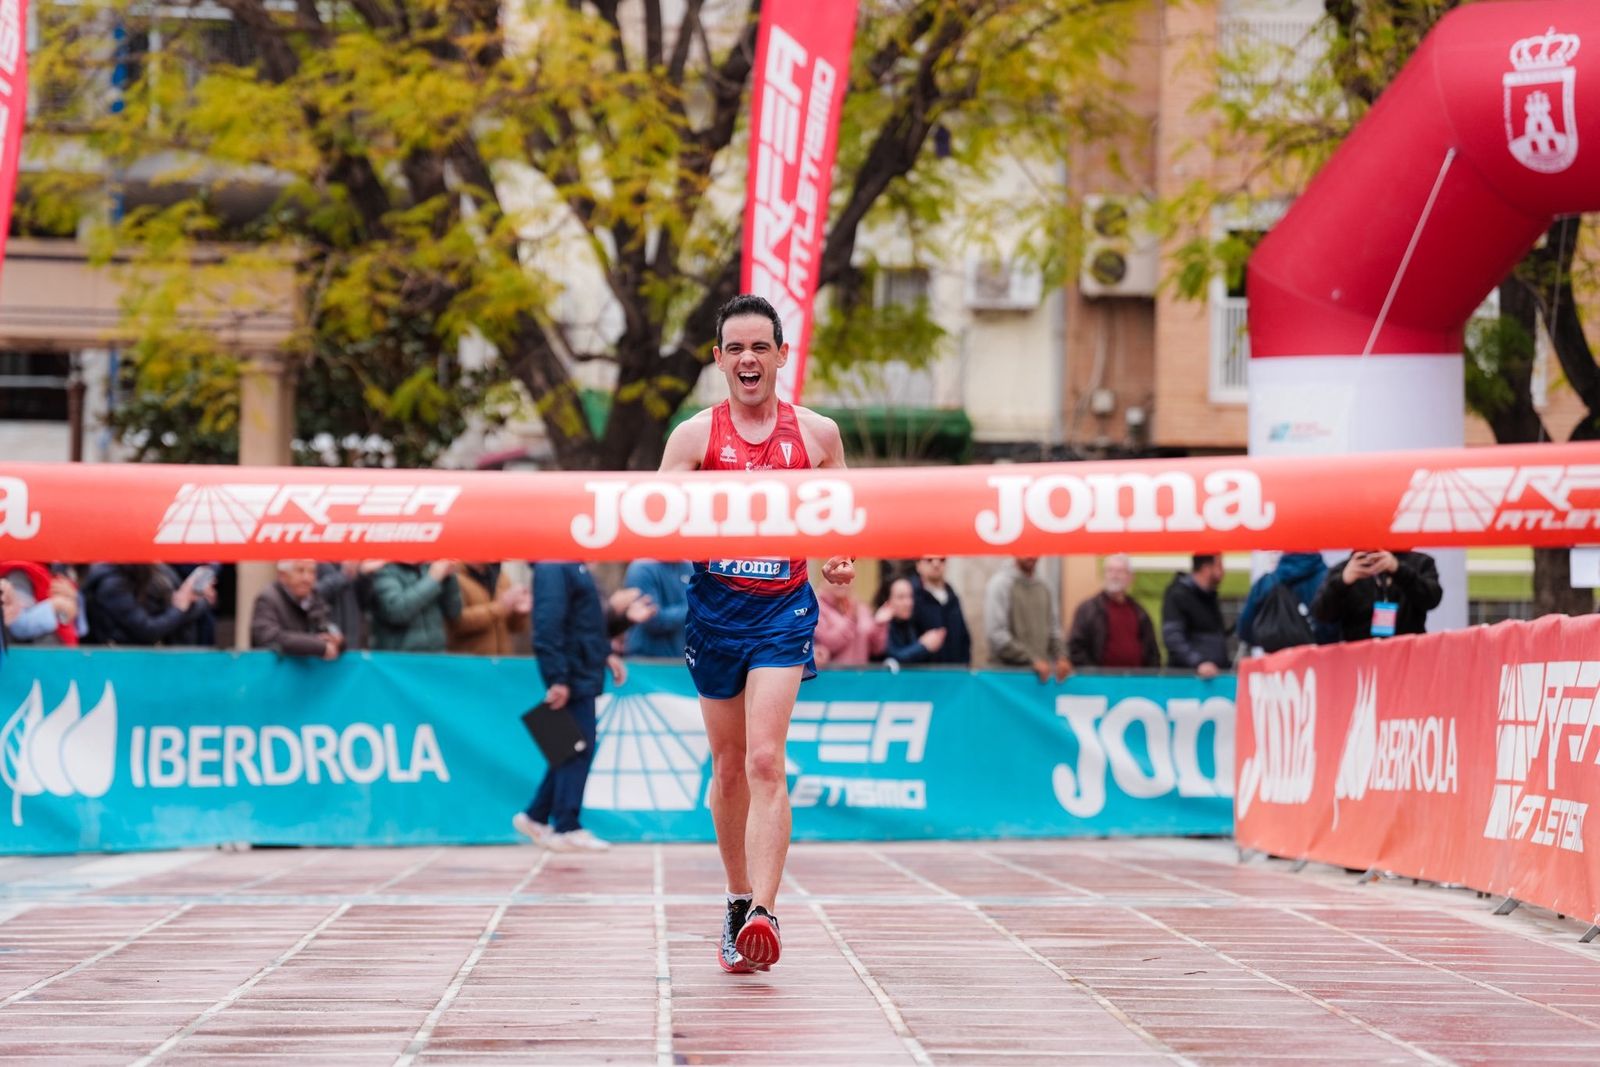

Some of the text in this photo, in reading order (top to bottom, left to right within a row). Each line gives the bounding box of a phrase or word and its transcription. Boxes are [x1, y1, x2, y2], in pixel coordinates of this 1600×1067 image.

[753, 25, 807, 283] RFEA
[787, 57, 836, 297] ATLETISMO
[256, 522, 443, 543] ATLETISMO
[267, 484, 462, 524] RFEA
[130, 722, 450, 788] IBERDROLA
[785, 700, 933, 775] FEA
